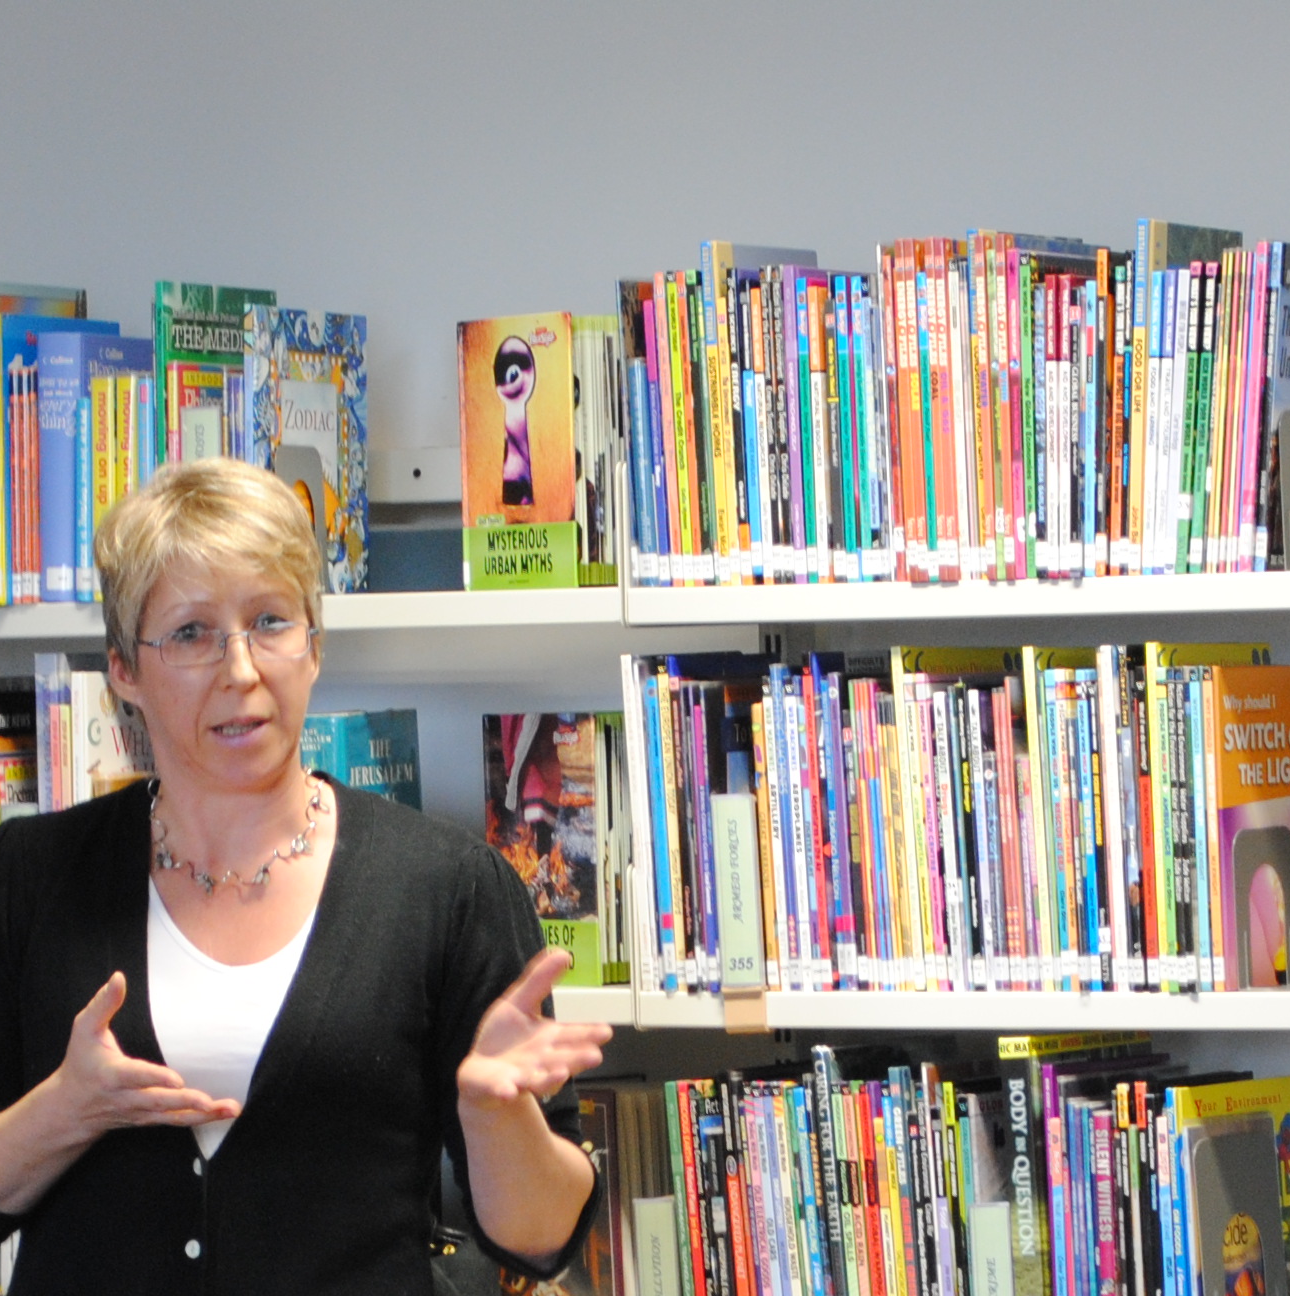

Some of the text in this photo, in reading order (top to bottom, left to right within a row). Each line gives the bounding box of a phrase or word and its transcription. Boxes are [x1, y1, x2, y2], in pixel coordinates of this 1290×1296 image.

[172, 324, 204, 349] THE
[730, 362, 741, 412] ENERGY
[930, 371, 940, 401] COAL
[1133, 338, 1144, 414] FOOD FOR LIFE
[285, 400, 335, 431] ZODIAC
[708, 356, 722, 458] SUSTAINABLE HOMES
[97, 391, 108, 505] moving on up
[486, 527, 548, 551] MYSTERIOUS
[484, 552, 553, 576] URBAN MYTHS
[1223, 693, 1268, 711] Why should
[369, 739, 392, 759] THE
[1223, 721, 1286, 751] SWITCH
[349, 762, 414, 787] JERUSALEM
[1238, 761, 1263, 787] THE
[562, 924, 576, 946] OF
[729, 957, 754, 971] 355
[1194, 1095, 1283, 1118] Your Environment
[814, 1060, 841, 1242] CARING FOR THE EARTH
[1008, 1078, 1035, 1257] BODY QUESTION
[1095, 1129, 1113, 1242] SILENT WITNESS
